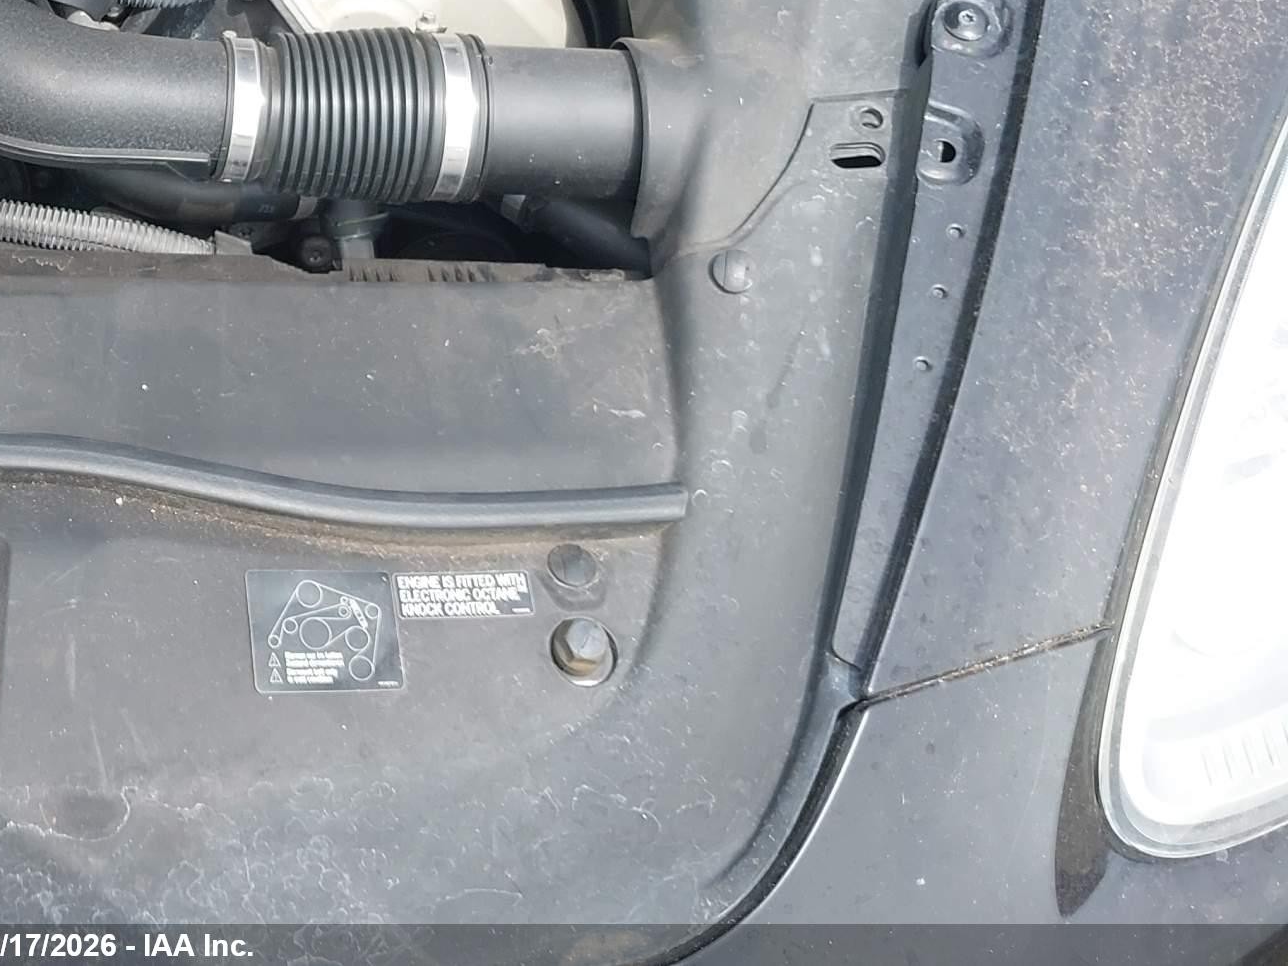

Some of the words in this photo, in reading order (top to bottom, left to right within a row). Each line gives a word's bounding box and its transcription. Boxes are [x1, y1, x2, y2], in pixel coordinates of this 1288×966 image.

[397, 575, 440, 589] ENGINE
[441, 575, 454, 588] IS
[454, 574, 495, 588] FITTED
[495, 573, 528, 593] WITH
[399, 588, 471, 603] ELECTRONIC
[472, 587, 520, 601] OCTANE
[402, 602, 443, 617] KNOCK
[444, 601, 500, 616] CONTROL
